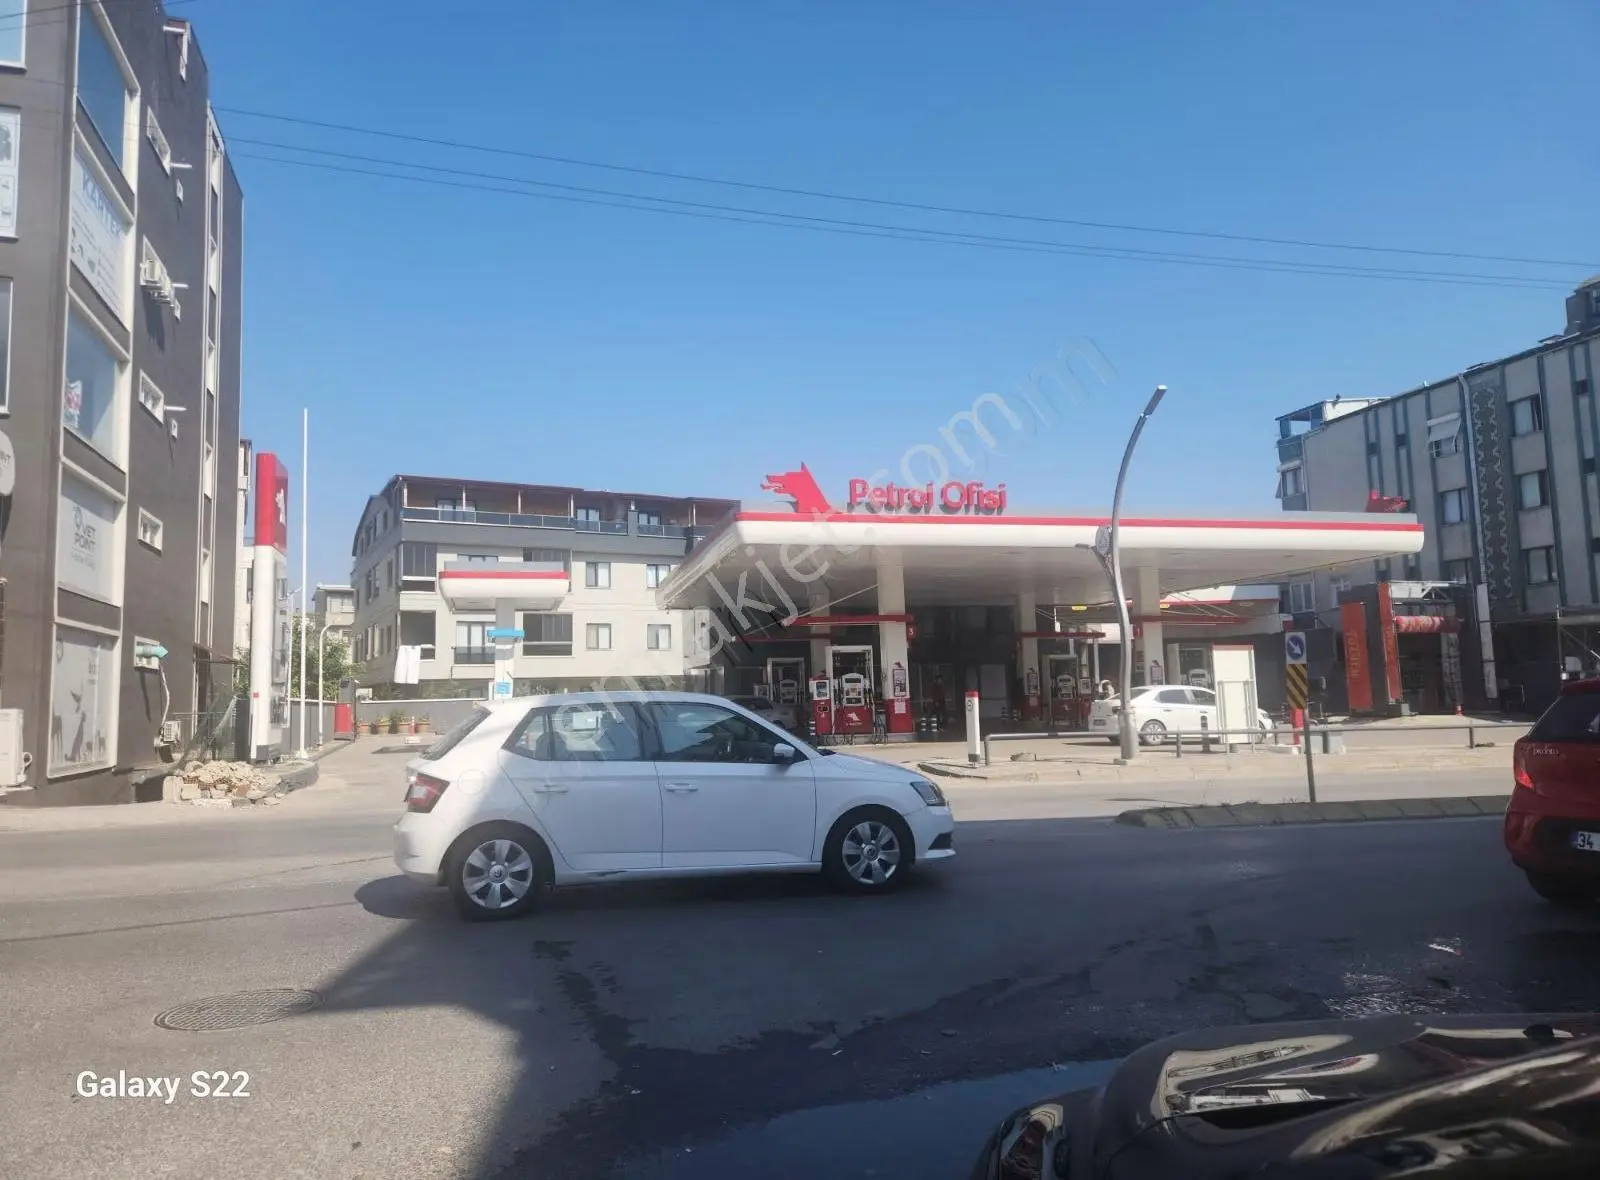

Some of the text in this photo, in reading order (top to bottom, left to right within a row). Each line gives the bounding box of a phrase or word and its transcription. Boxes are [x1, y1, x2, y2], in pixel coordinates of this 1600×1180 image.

[848, 479, 1007, 512] Petrol Ofisi
[1577, 832, 1594, 849] 34
